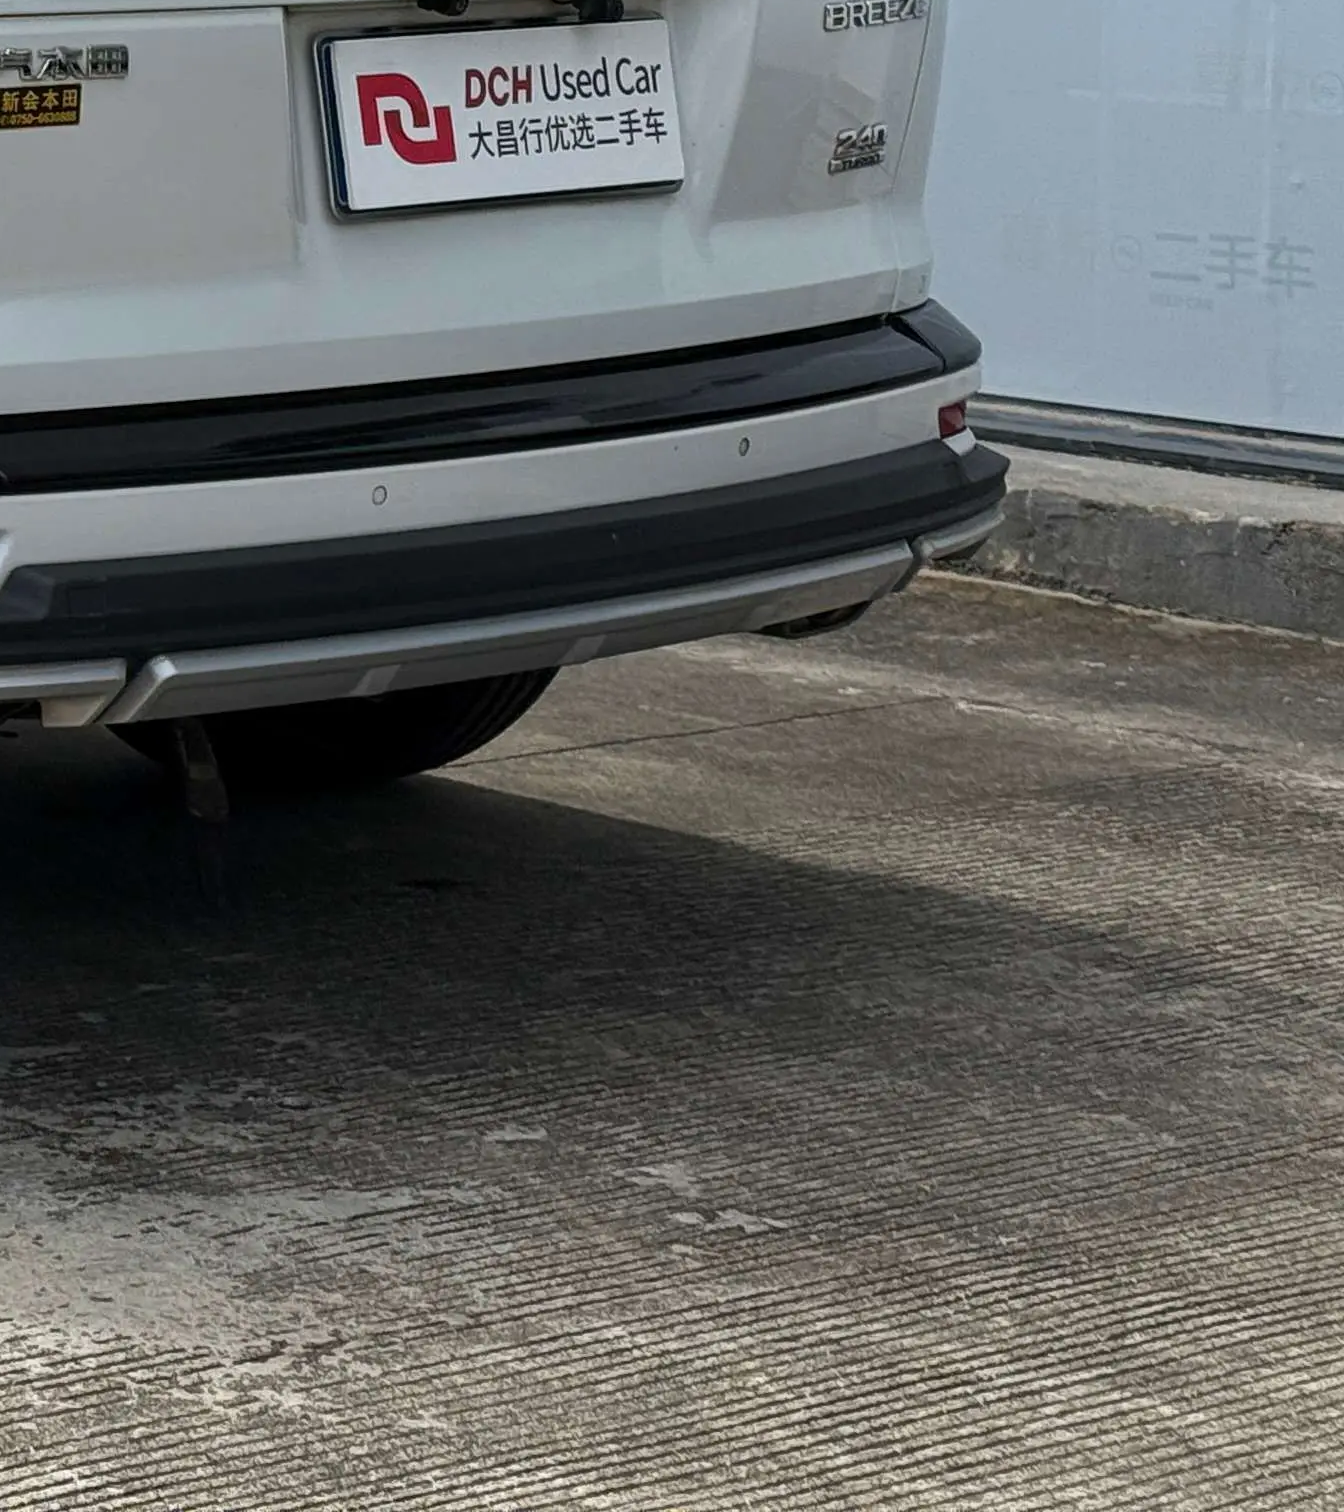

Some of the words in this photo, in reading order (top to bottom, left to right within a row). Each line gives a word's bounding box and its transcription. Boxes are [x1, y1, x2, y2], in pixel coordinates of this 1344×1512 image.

[465, 65, 532, 108] DCH
[540, 56, 609, 102] Used
[615, 57, 661, 95] Car
[469, 107, 668, 161] 大昌行优选二手车
[834, 123, 888, 155] 240
